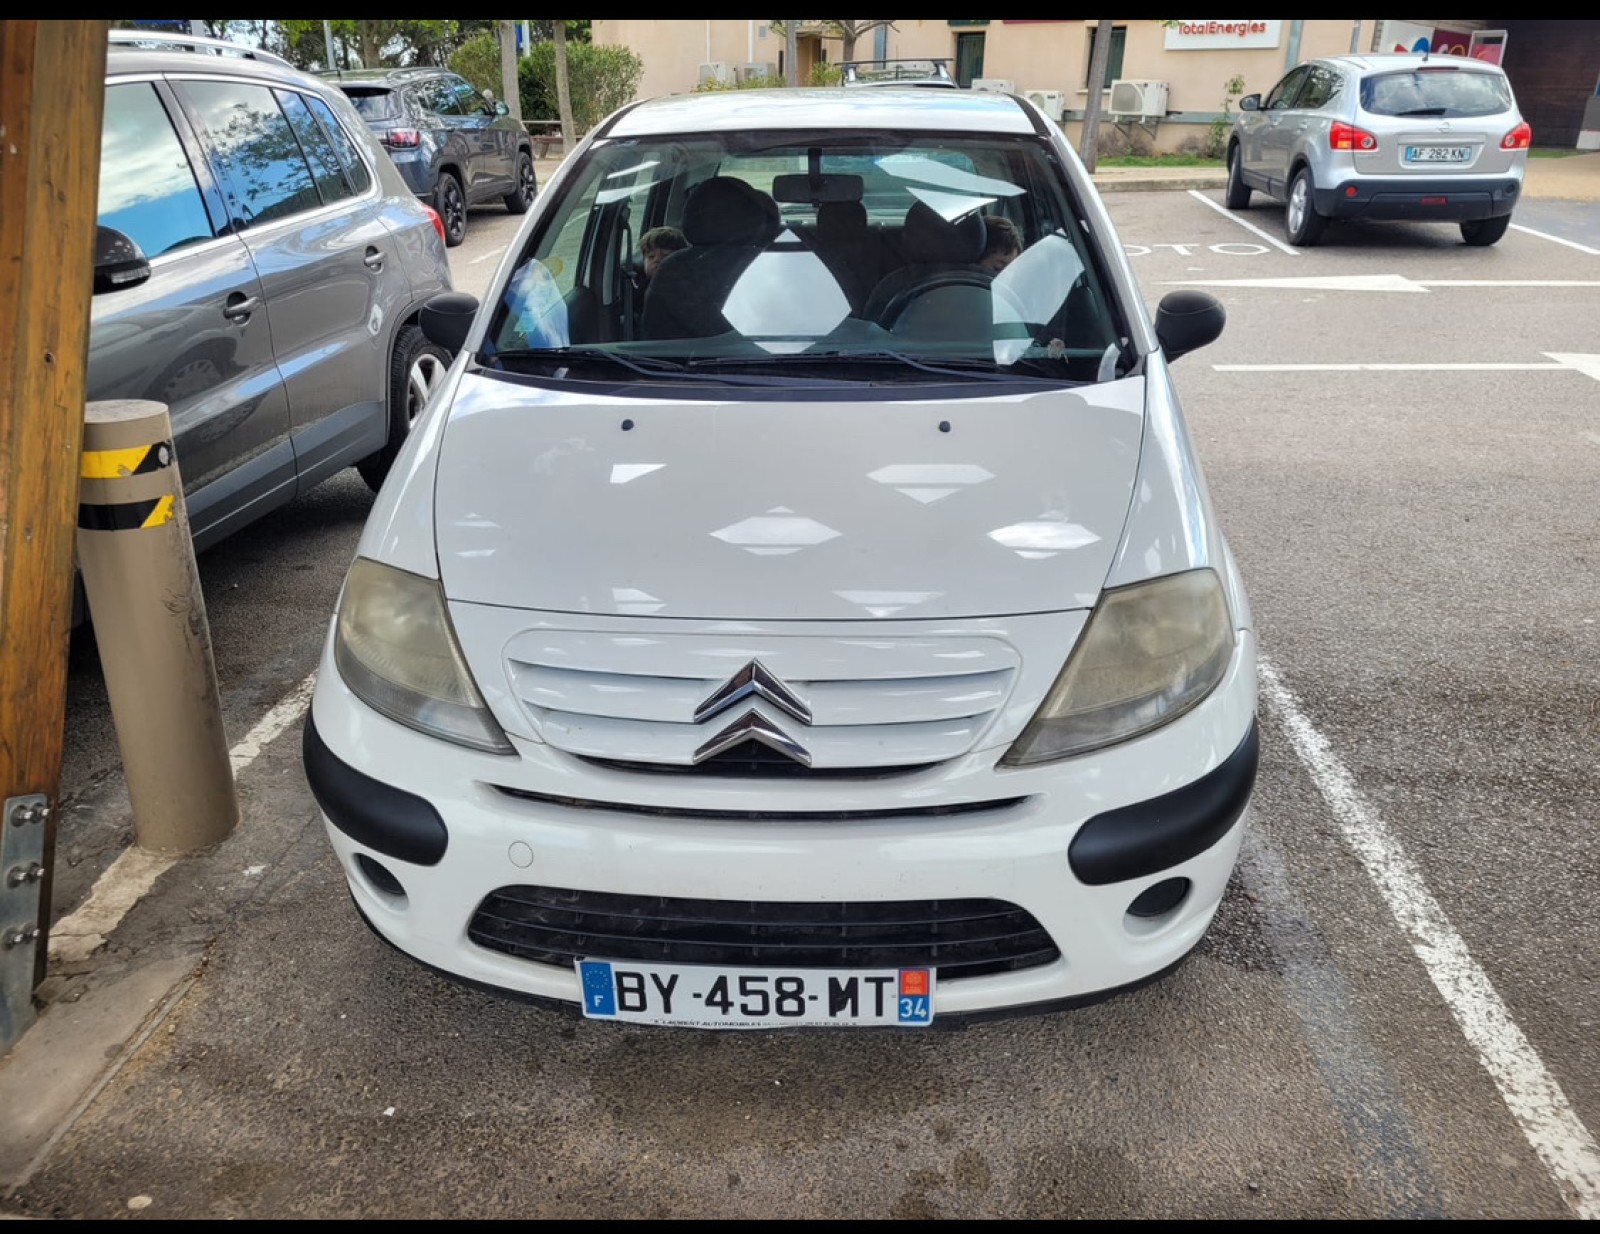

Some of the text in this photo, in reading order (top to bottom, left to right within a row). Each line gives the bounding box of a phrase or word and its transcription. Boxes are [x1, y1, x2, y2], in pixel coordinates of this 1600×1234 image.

[1179, 20, 1266, 38] TotalEnergies
[594, 995, 603, 1008] F
[900, 998, 927, 1018] 34
